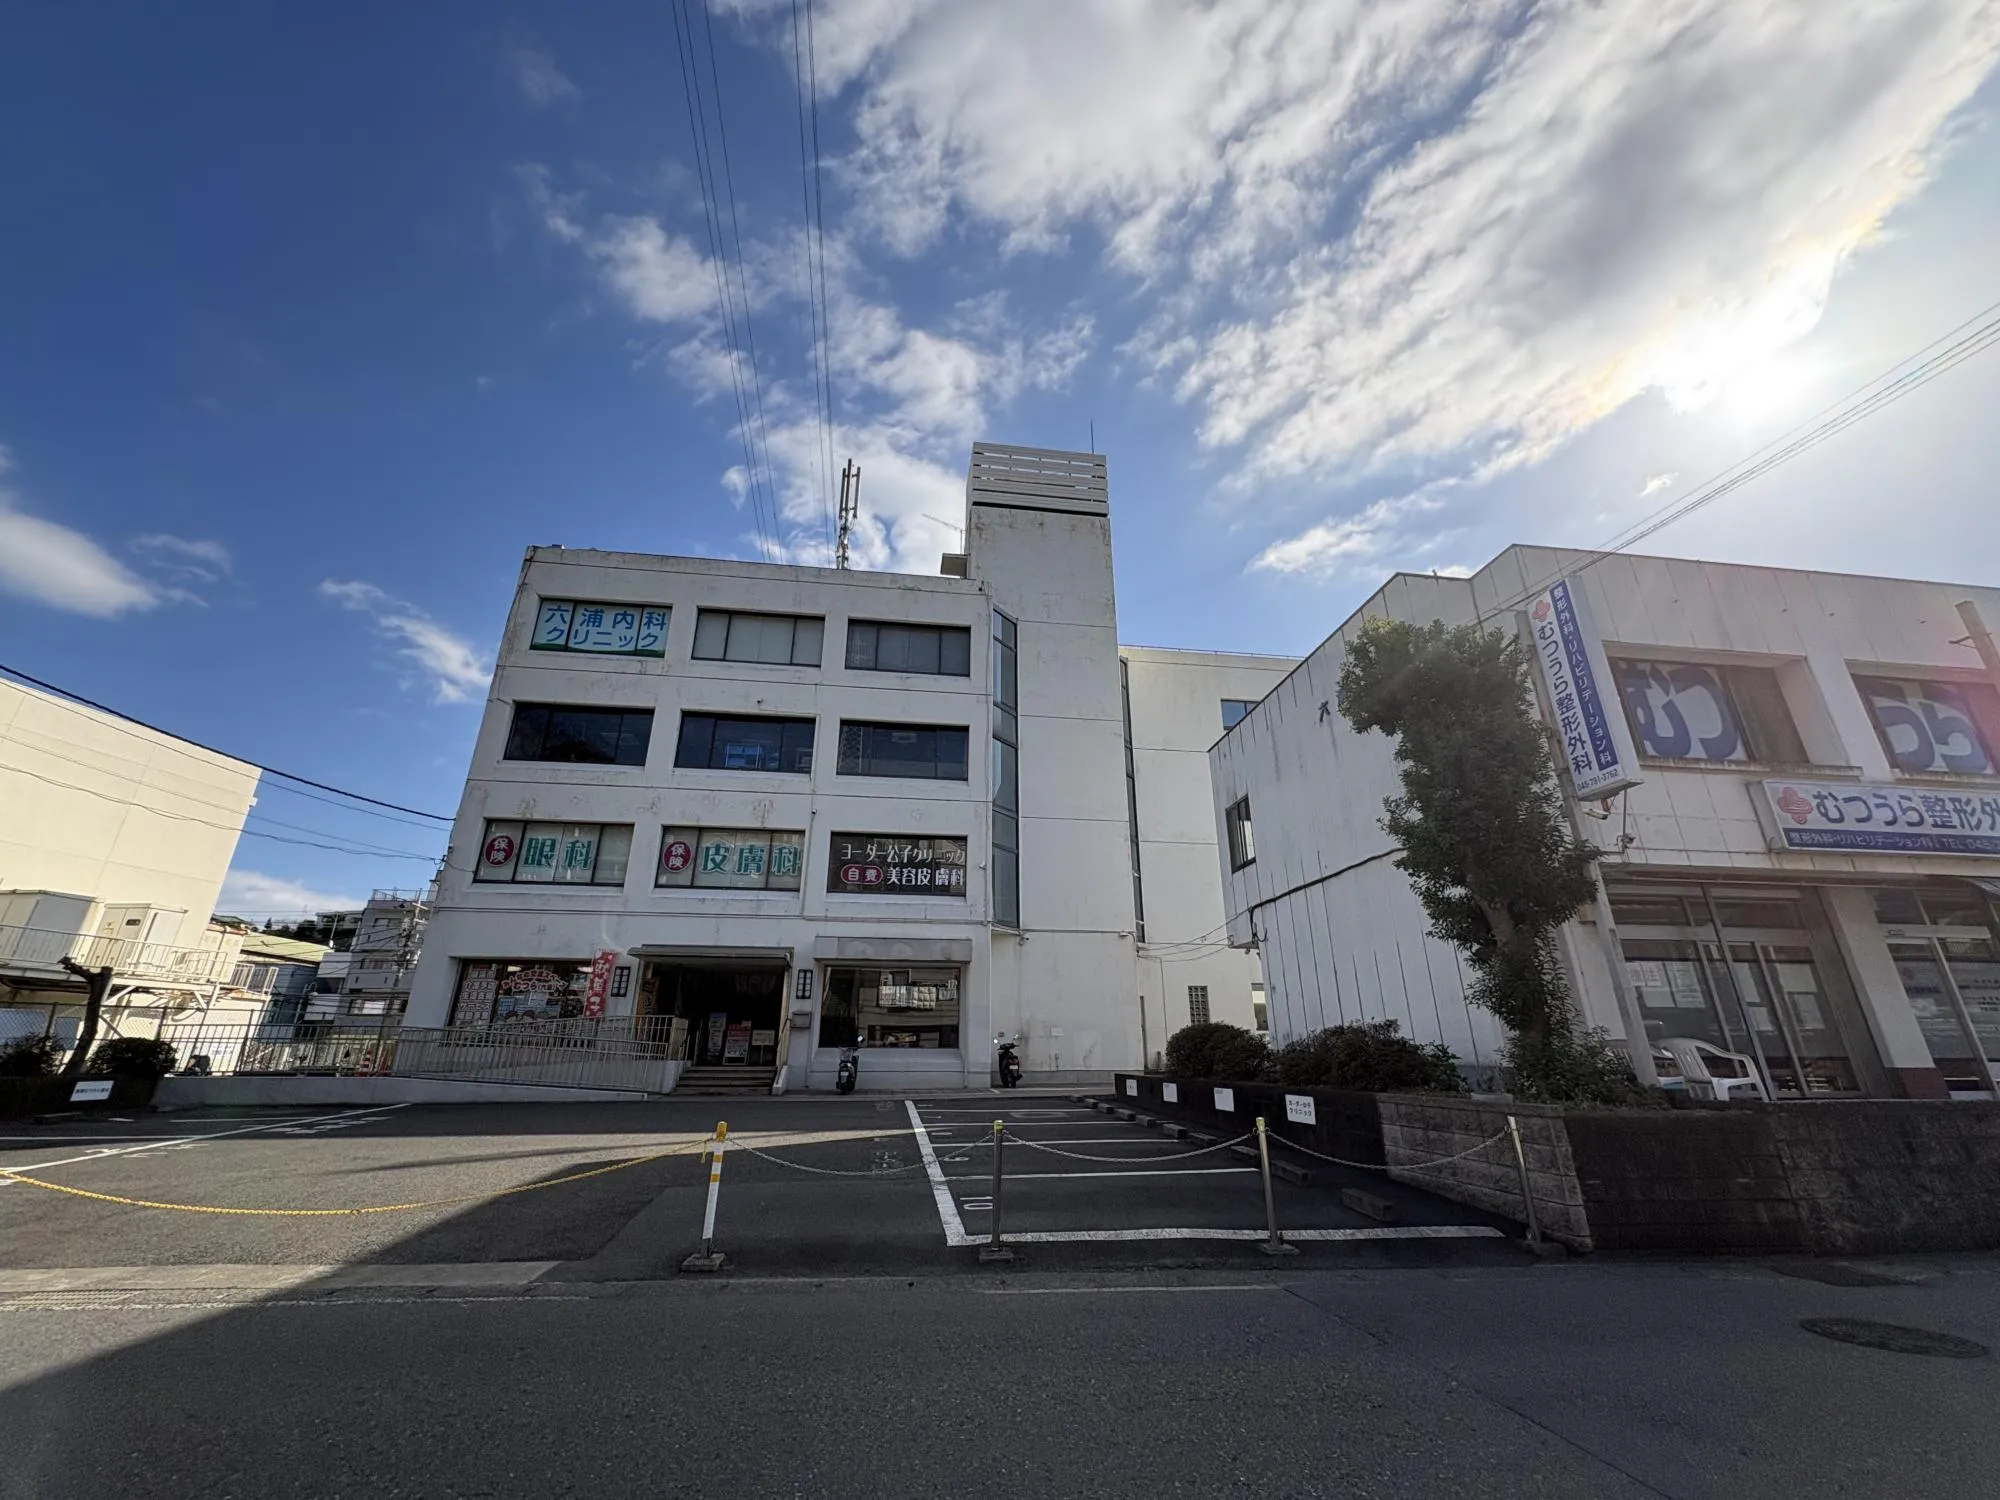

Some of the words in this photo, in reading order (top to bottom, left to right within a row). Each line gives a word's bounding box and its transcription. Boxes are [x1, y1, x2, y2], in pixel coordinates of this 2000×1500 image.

[545, 605, 666, 631] 六浦内科
[546, 627, 659, 649] クリニック
[1537, 621, 1592, 775] むつうら整形外科
[489, 837, 509, 863] 保険
[523, 838, 594, 869] 眼科
[668, 843, 686, 869] 保険
[701, 843, 800, 875] 皮膚科
[841, 843, 966, 864] ヨーダー公子クリニック
[848, 867, 877, 882] 自費
[886, 867, 964, 886] 美容皮膚科
